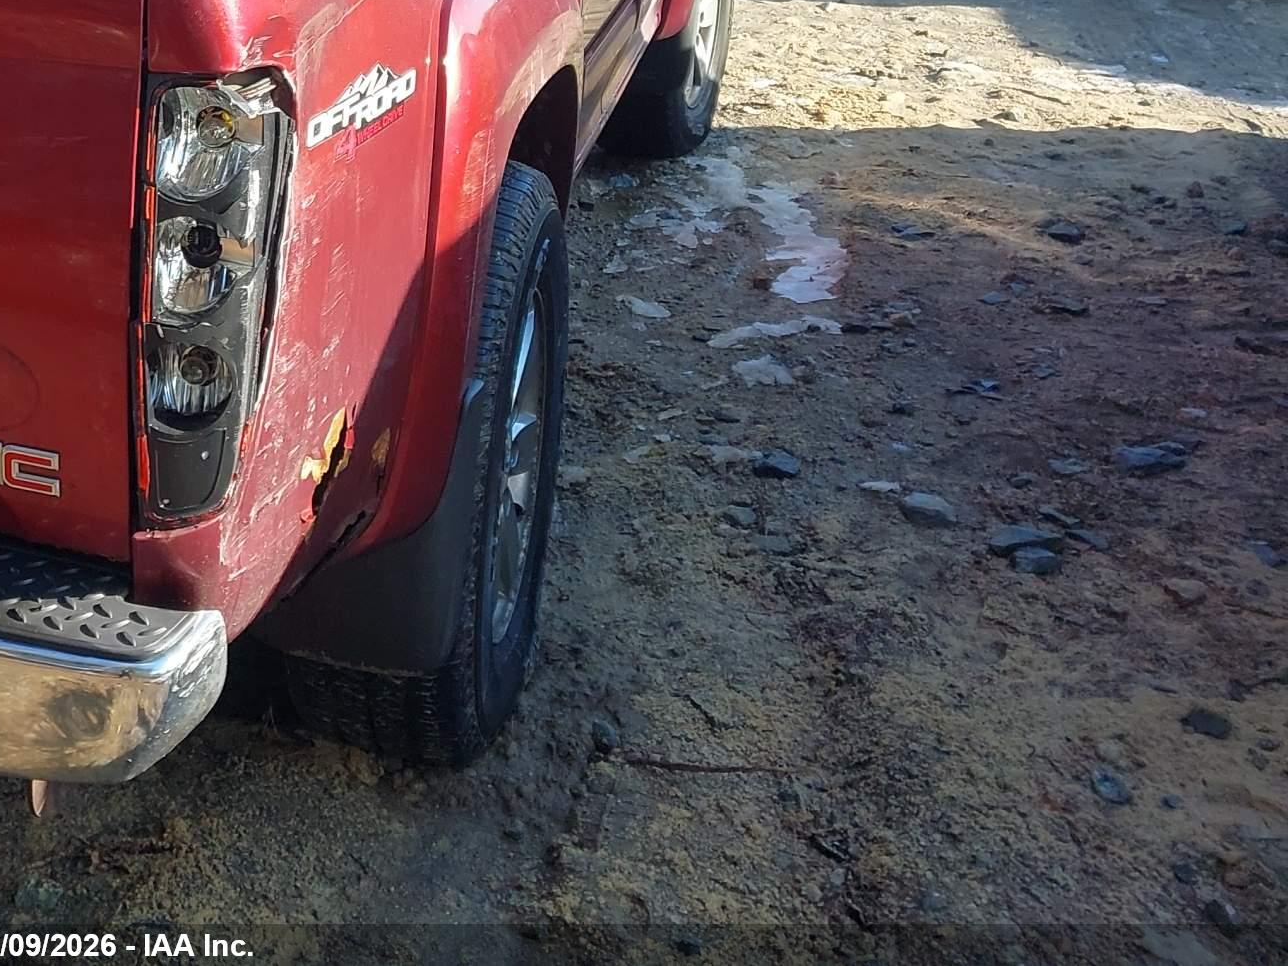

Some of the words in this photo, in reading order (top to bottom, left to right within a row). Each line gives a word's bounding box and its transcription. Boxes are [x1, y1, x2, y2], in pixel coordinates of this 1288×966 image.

[334, 125, 358, 163] 4
[357, 121, 383, 144] WHEEL
[382, 104, 405, 126] DRIVE
